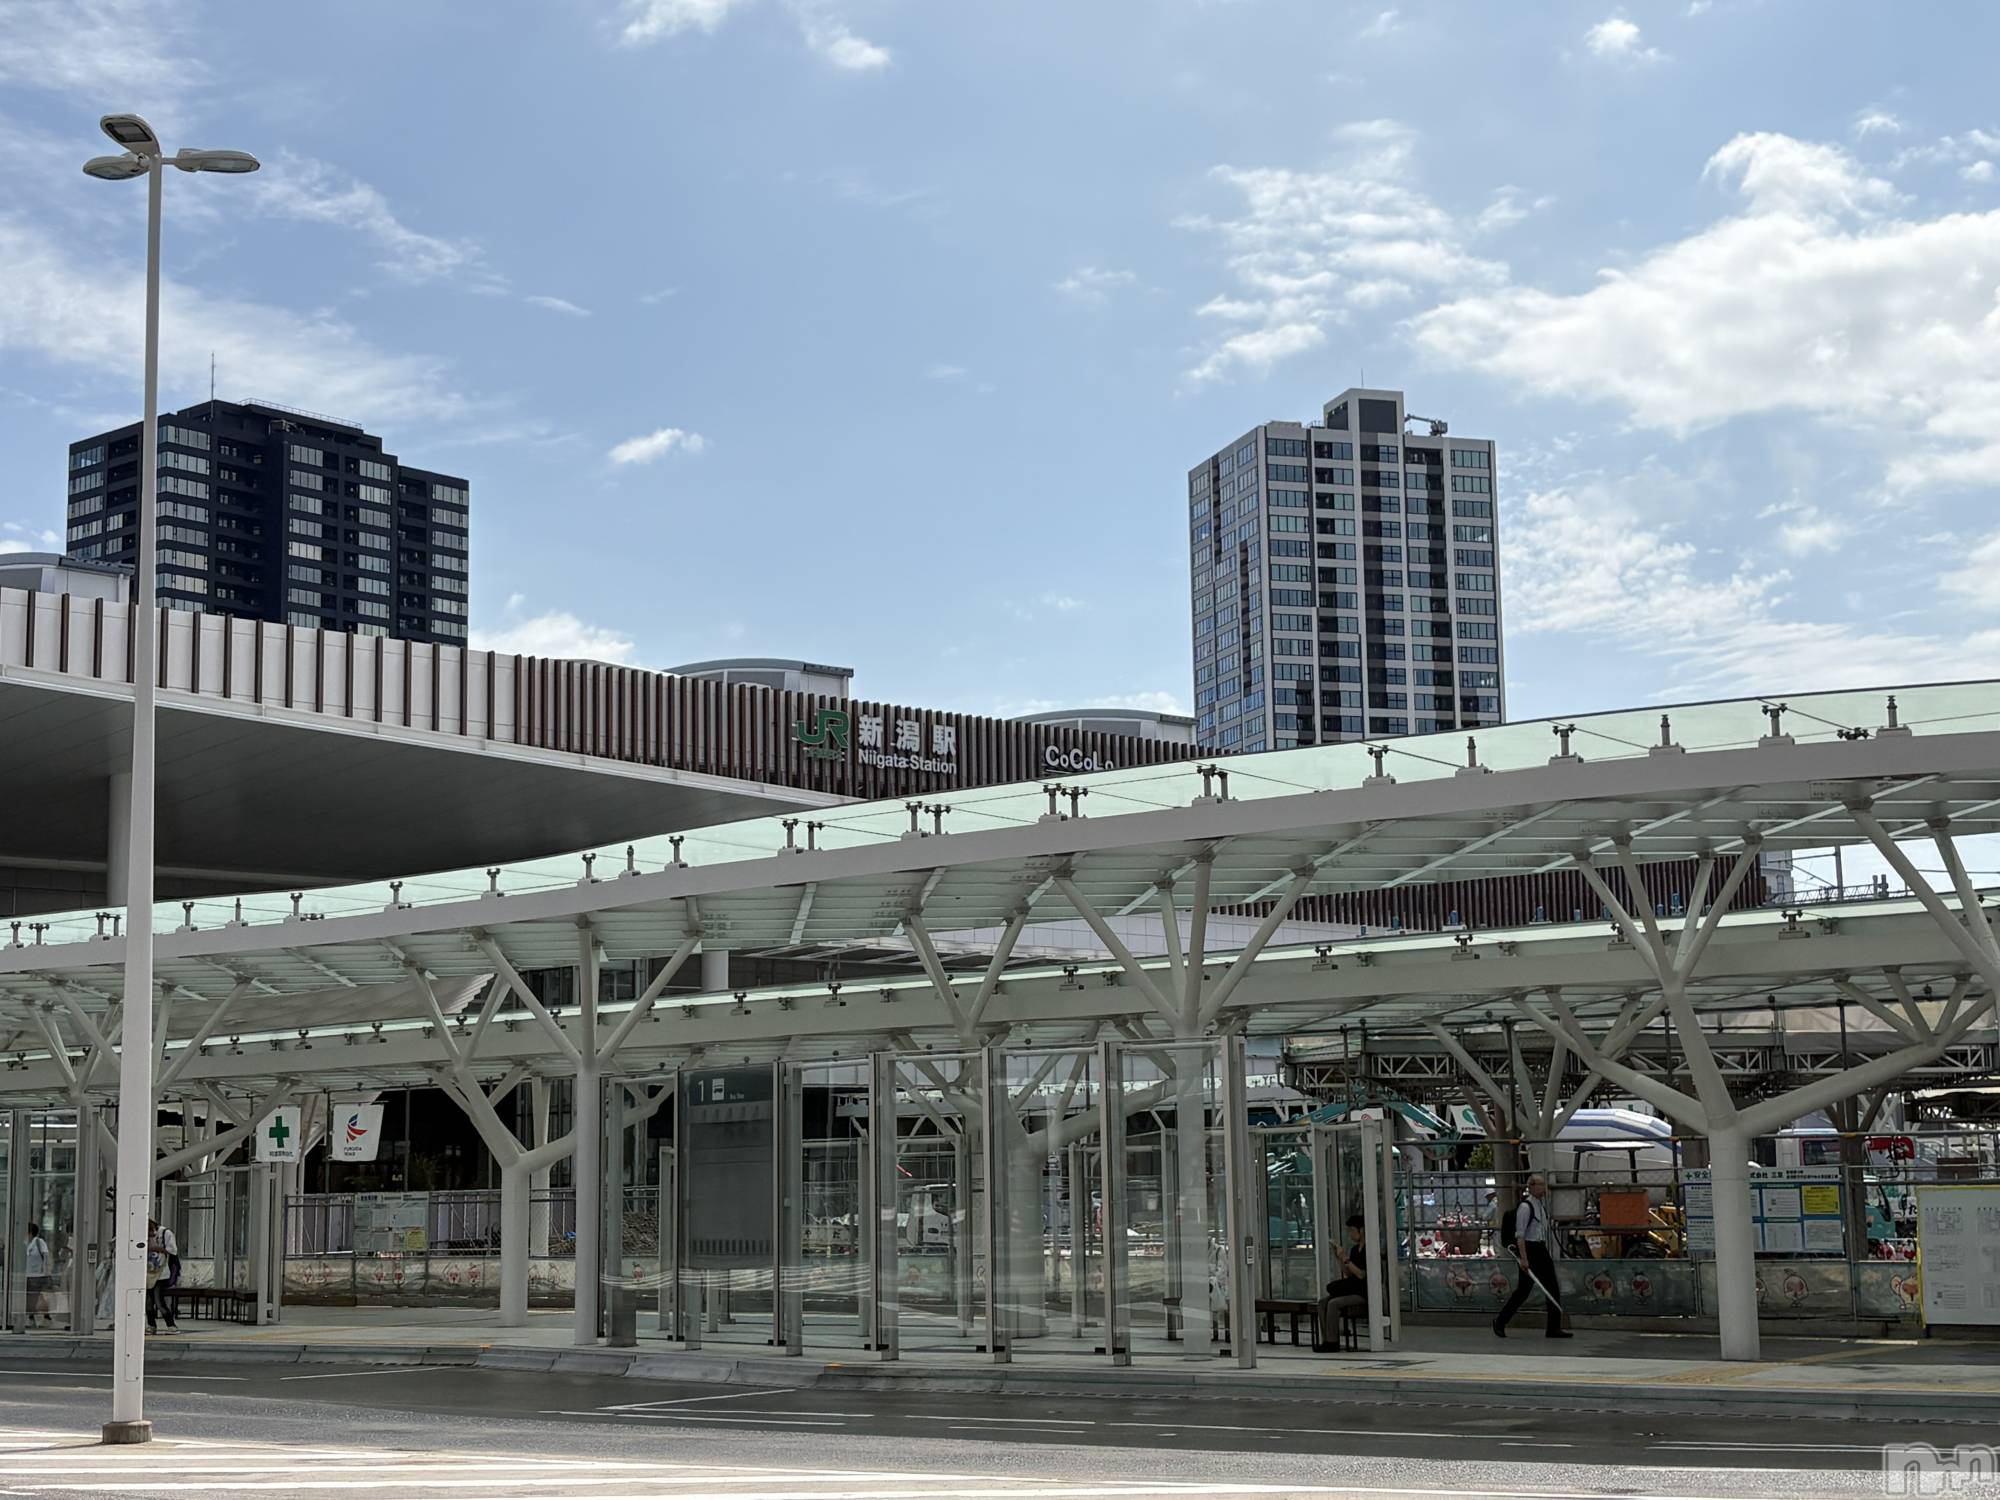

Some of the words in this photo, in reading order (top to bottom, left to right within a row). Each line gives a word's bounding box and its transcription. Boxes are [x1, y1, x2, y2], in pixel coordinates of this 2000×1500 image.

[796, 709, 849, 748] JR
[858, 714, 957, 757] 新潟駅
[858, 749, 906, 770] Niigata
[910, 754, 957, 775] Station
[698, 1079, 705, 1102] 1
